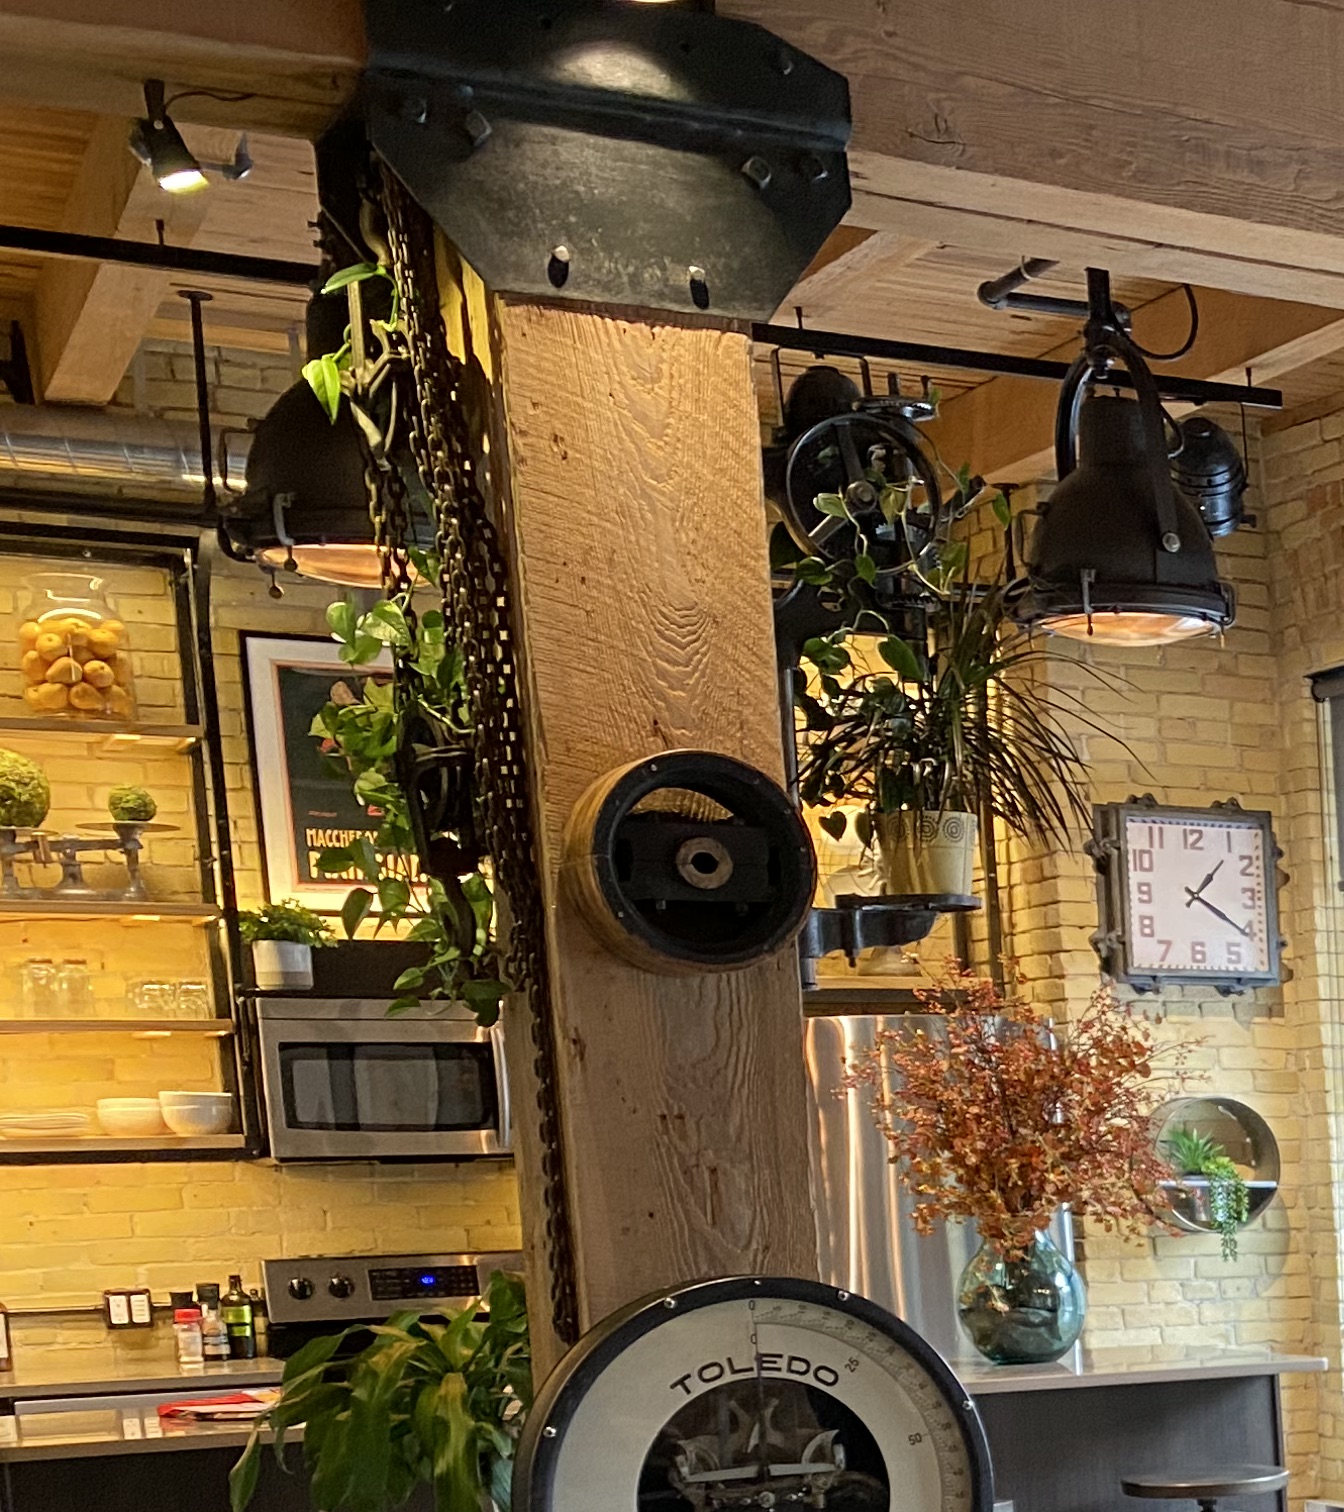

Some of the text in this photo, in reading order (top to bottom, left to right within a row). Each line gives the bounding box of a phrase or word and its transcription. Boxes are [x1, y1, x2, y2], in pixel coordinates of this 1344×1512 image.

[1148, 825, 1232, 853] 11 12 1
[1133, 849, 1154, 872] 10
[1238, 855, 1254, 877] 2
[1137, 882, 1152, 904] 9
[1241, 887, 1256, 910] 3
[1139, 915, 1155, 938] 8
[1242, 920, 1257, 942] 4
[1157, 940, 1173, 962] 7
[1191, 941, 1206, 964] 6
[1226, 942, 1241, 965] 5
[669, 1353, 839, 1395] TOLEDO
[844, 1356, 860, 1373] 25
[908, 1432, 923, 1446] 50
